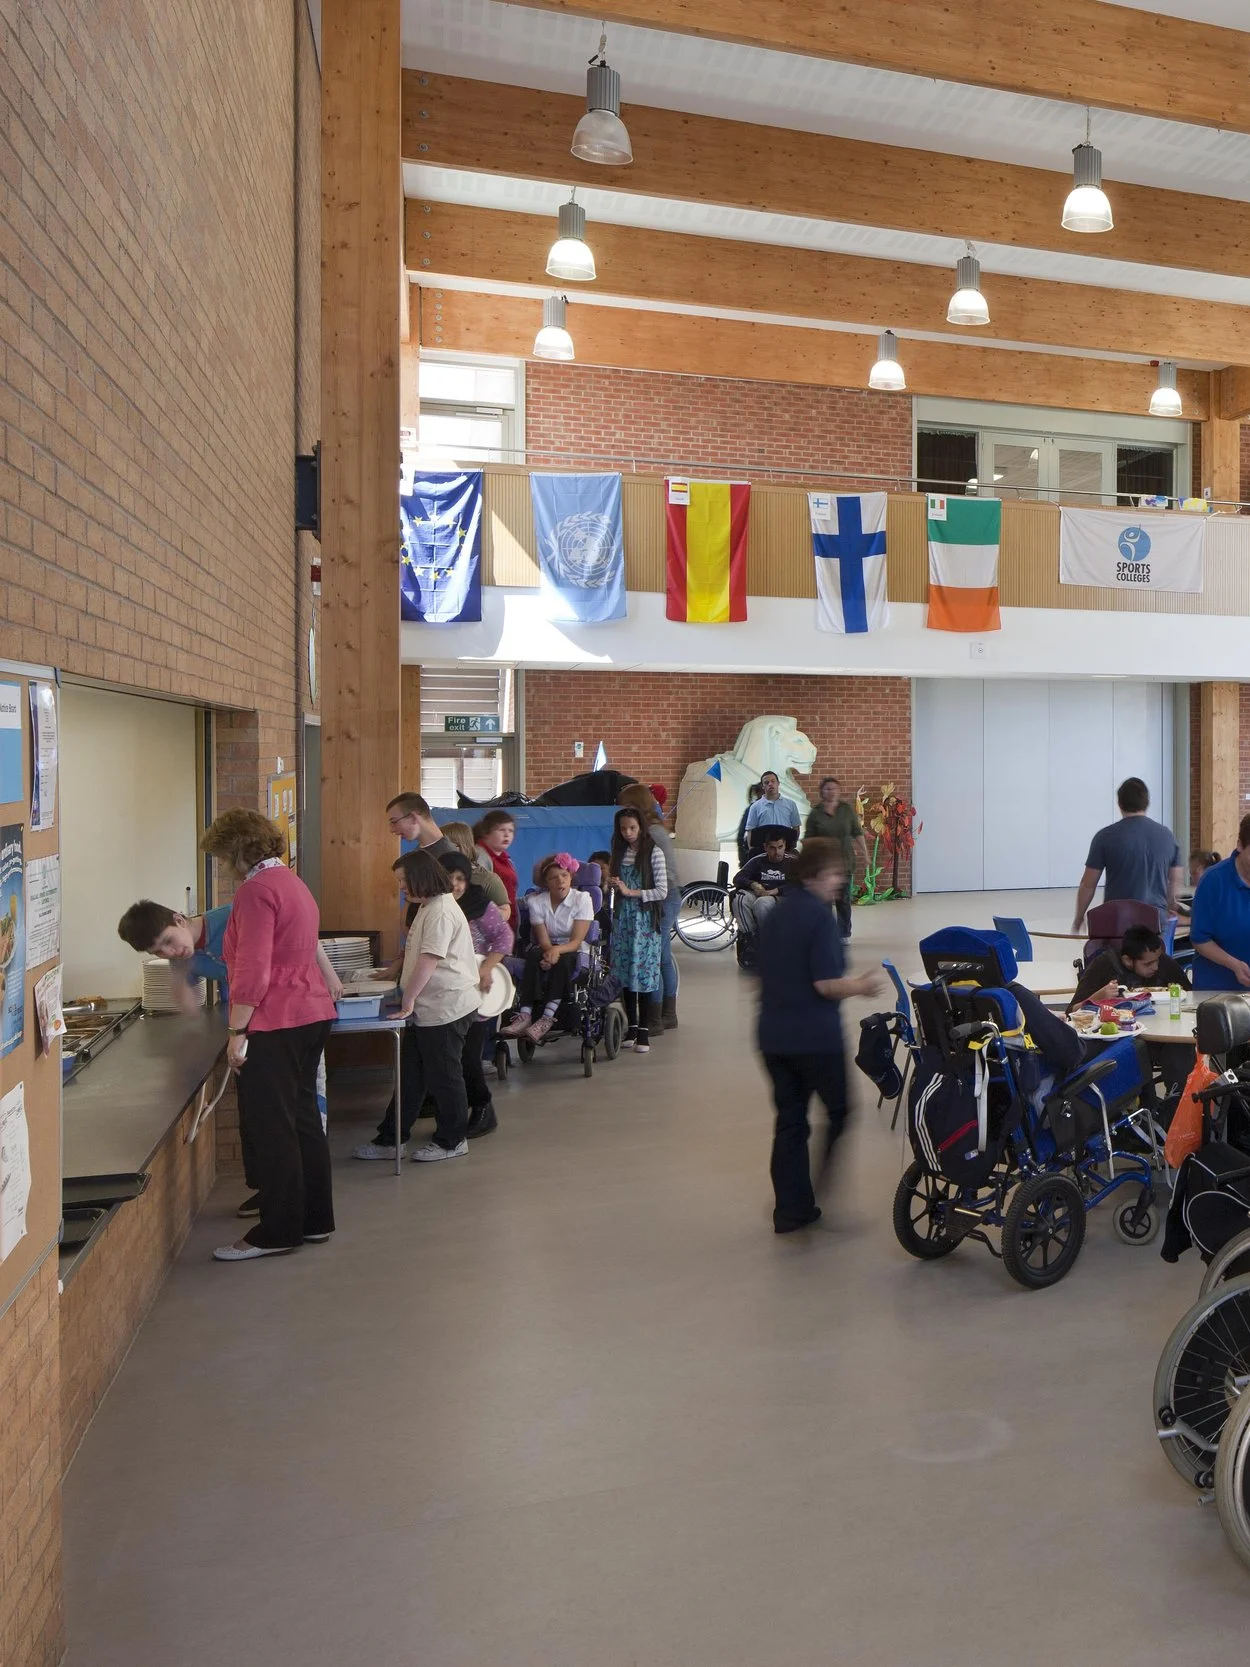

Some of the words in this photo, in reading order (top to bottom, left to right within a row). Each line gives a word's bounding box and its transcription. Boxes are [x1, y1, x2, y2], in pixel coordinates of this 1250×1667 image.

[1116, 561, 1151, 575] SPORTS
[1116, 572, 1151, 583] COLLEGES
[447, 716, 466, 724] Fire
